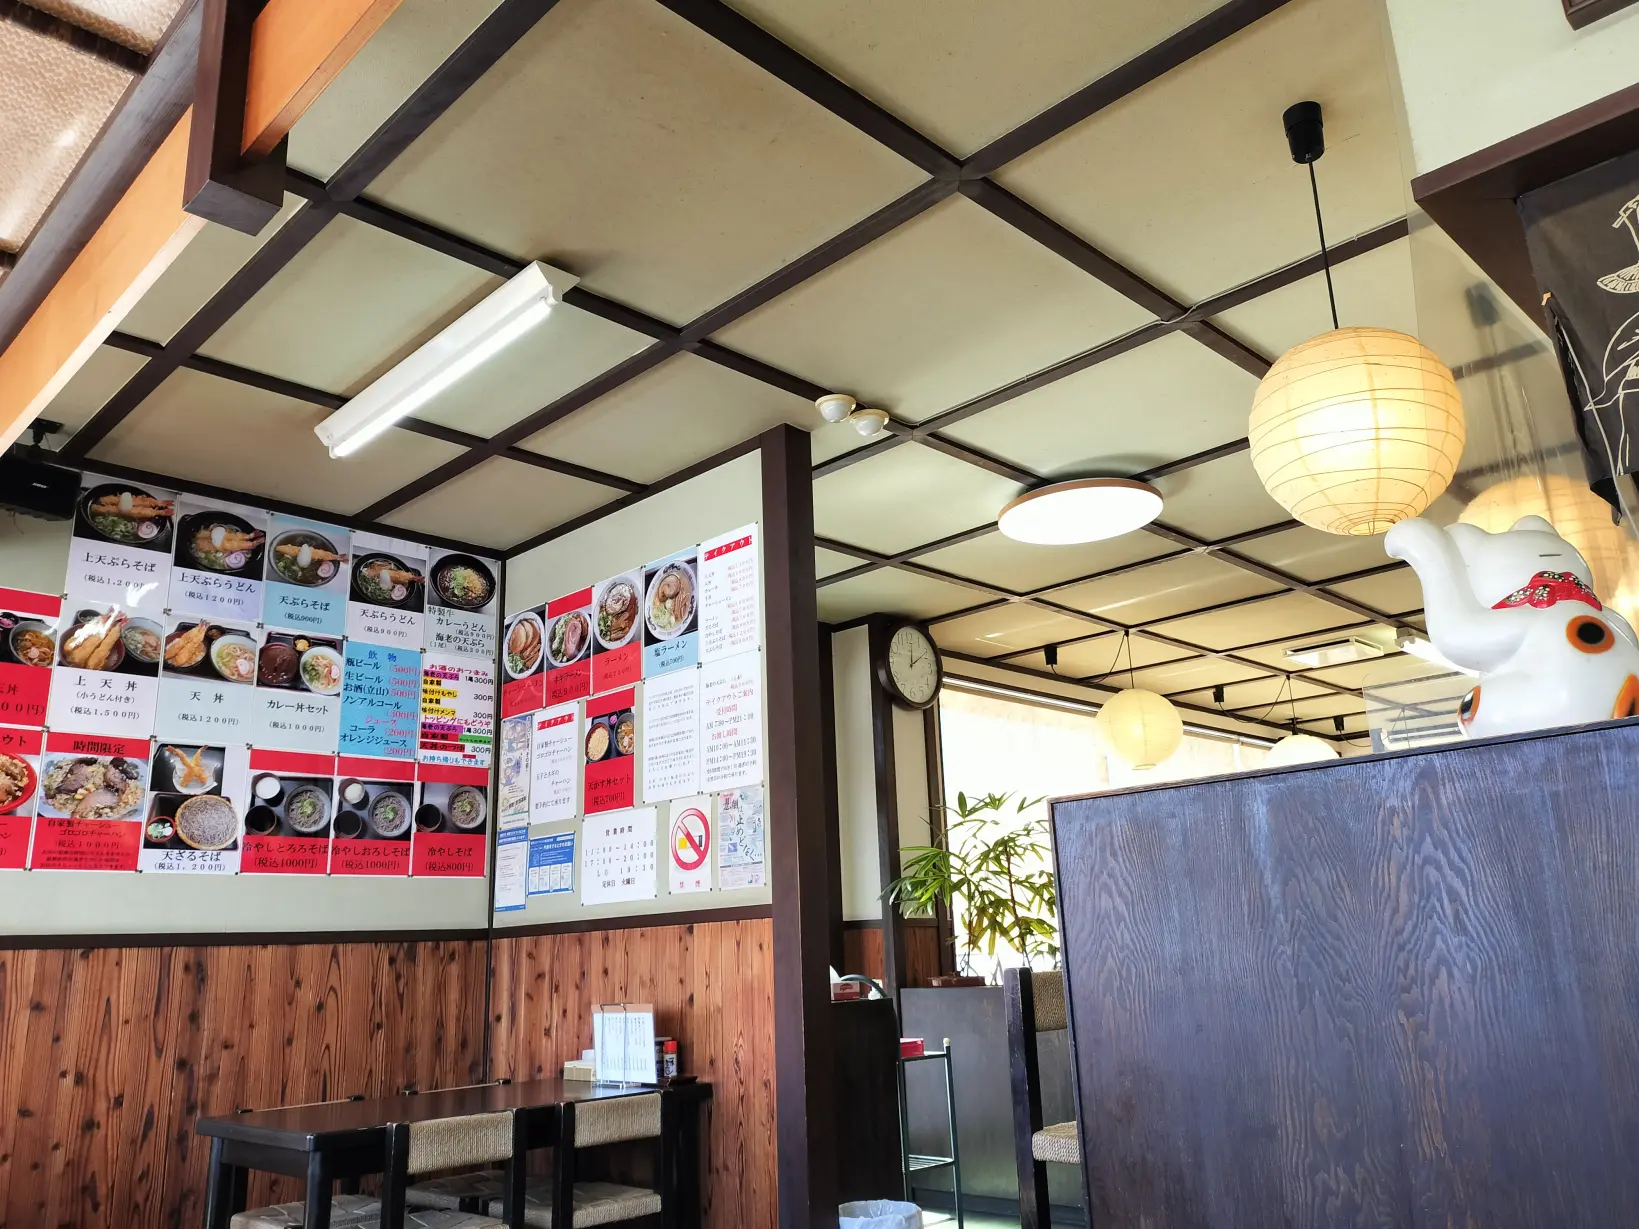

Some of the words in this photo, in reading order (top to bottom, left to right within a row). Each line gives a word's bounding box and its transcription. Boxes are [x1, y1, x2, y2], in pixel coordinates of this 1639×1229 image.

[704, 536, 752, 561] テイクアウト
[81, 551, 157, 573] 上天ぷらそば
[178, 571, 256, 594] 上天ぷらうどん
[184, 590, 244, 607] (税込1200円)
[279, 595, 331, 612] 天ぷらそば
[360, 608, 416, 626] 天ぷらうどん
[428, 605, 454, 617] 特製牛
[284, 612, 323, 625] (税込900円)
[436, 617, 487, 633] カレーうどん
[363, 626, 408, 638] (税込900円)
[435, 632, 485, 648] 海老の天ぷら
[653, 639, 688, 658] 塩ラーメン
[368, 650, 397, 663] 飲物
[604, 652, 629, 667] ラーメン
[344, 657, 382, 670] 瓶ビール
[429, 663, 489, 677] お酒のおつまみ
[927, 662, 933, 675] 3
[74, 675, 138, 692] 上天丼
[344, 671, 384, 684] 生ビール
[343, 683, 389, 696] お酒(立山)
[422, 688, 458, 698] 味付けもやし
[474, 694, 494, 702] 300円
[76, 690, 136, 704] (小うどん付き)
[190, 691, 224, 704] 天丼
[343, 695, 403, 710] ノンアルコール
[266, 699, 329, 715] カレー丼セット
[422, 707, 456, 717] 味付けメンマ
[473, 711, 493, 720] 300円
[178, 713, 240, 726] (税込1200円)
[365, 715, 397, 727] ジュース
[424, 715, 491, 728] トッピングにもどうぞ
[269, 721, 325, 733] (税込1000円)
[349, 724, 376, 734] コーラ
[340, 733, 408, 748] オレンジジュース
[73, 740, 126, 755] 時間限定
[471, 745, 491, 755] 300円
[422, 754, 486, 766] お持ち帰りもできます
[587, 773, 633, 791] 天かす丼セット
[48, 819, 121, 829] 自家製チャーシュー
[59, 829, 126, 839] ゴロゴロチャーハン
[605, 825, 633, 837] 営業時間
[242, 841, 329, 855] 冷やしとろろそば
[331, 844, 410, 858] 冷やしおろしそば
[427, 846, 473, 858] 冷やしそば
[162, 850, 221, 862] 天ざるそば
[254, 857, 318, 869] (税込1000円)
[341, 857, 400, 870] (税込1000円)
[425, 862, 474, 872] (税込800円)
